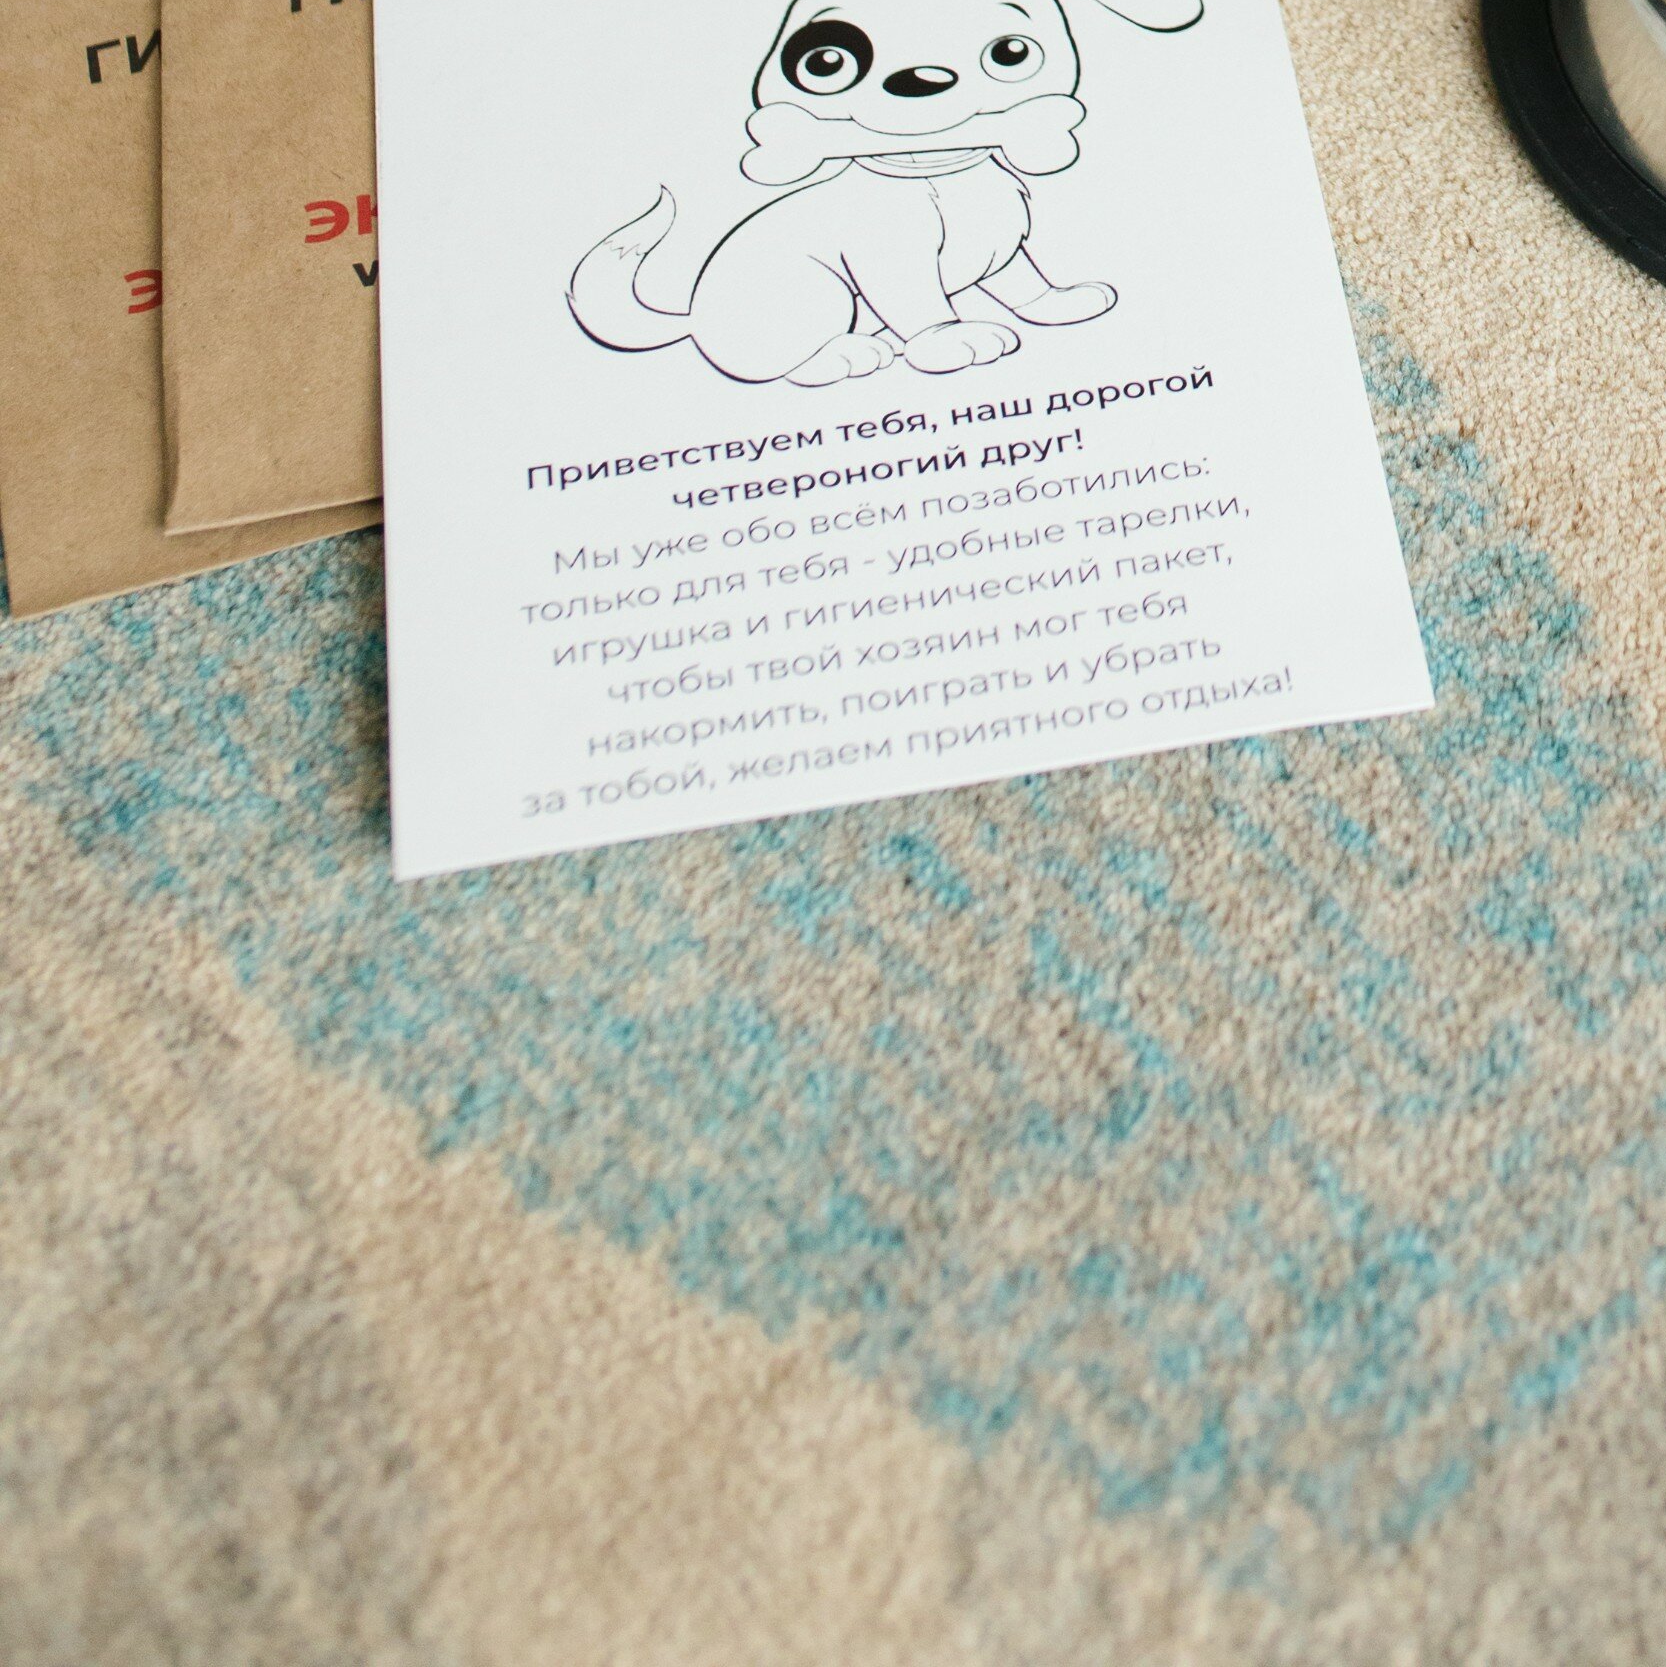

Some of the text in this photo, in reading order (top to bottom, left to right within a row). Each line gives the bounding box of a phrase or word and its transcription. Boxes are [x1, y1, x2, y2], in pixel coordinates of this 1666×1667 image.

[526, 364, 1214, 492] Приветствуем тебя, наш дорогой
[671, 427, 1084, 510] четвероногий друг!
[519, 585, 661, 624] только
[672, 572, 746, 606] для
[758, 552, 849, 587] тебя
[887, 524, 1065, 575] удобные
[1075, 496, 1251, 538] тарелки,
[553, 457, 1211, 576] Мы уже обо всём позаботились:
[552, 543, 1233, 667] игрушка и гигиенический пакет,
[607, 591, 1188, 703] чтобы твой хозяин мог тебя
[522, 665, 1294, 818] за тобой, желаем приятного отдыха!
[587, 638, 1221, 757] накормить, поиграть и убрать
